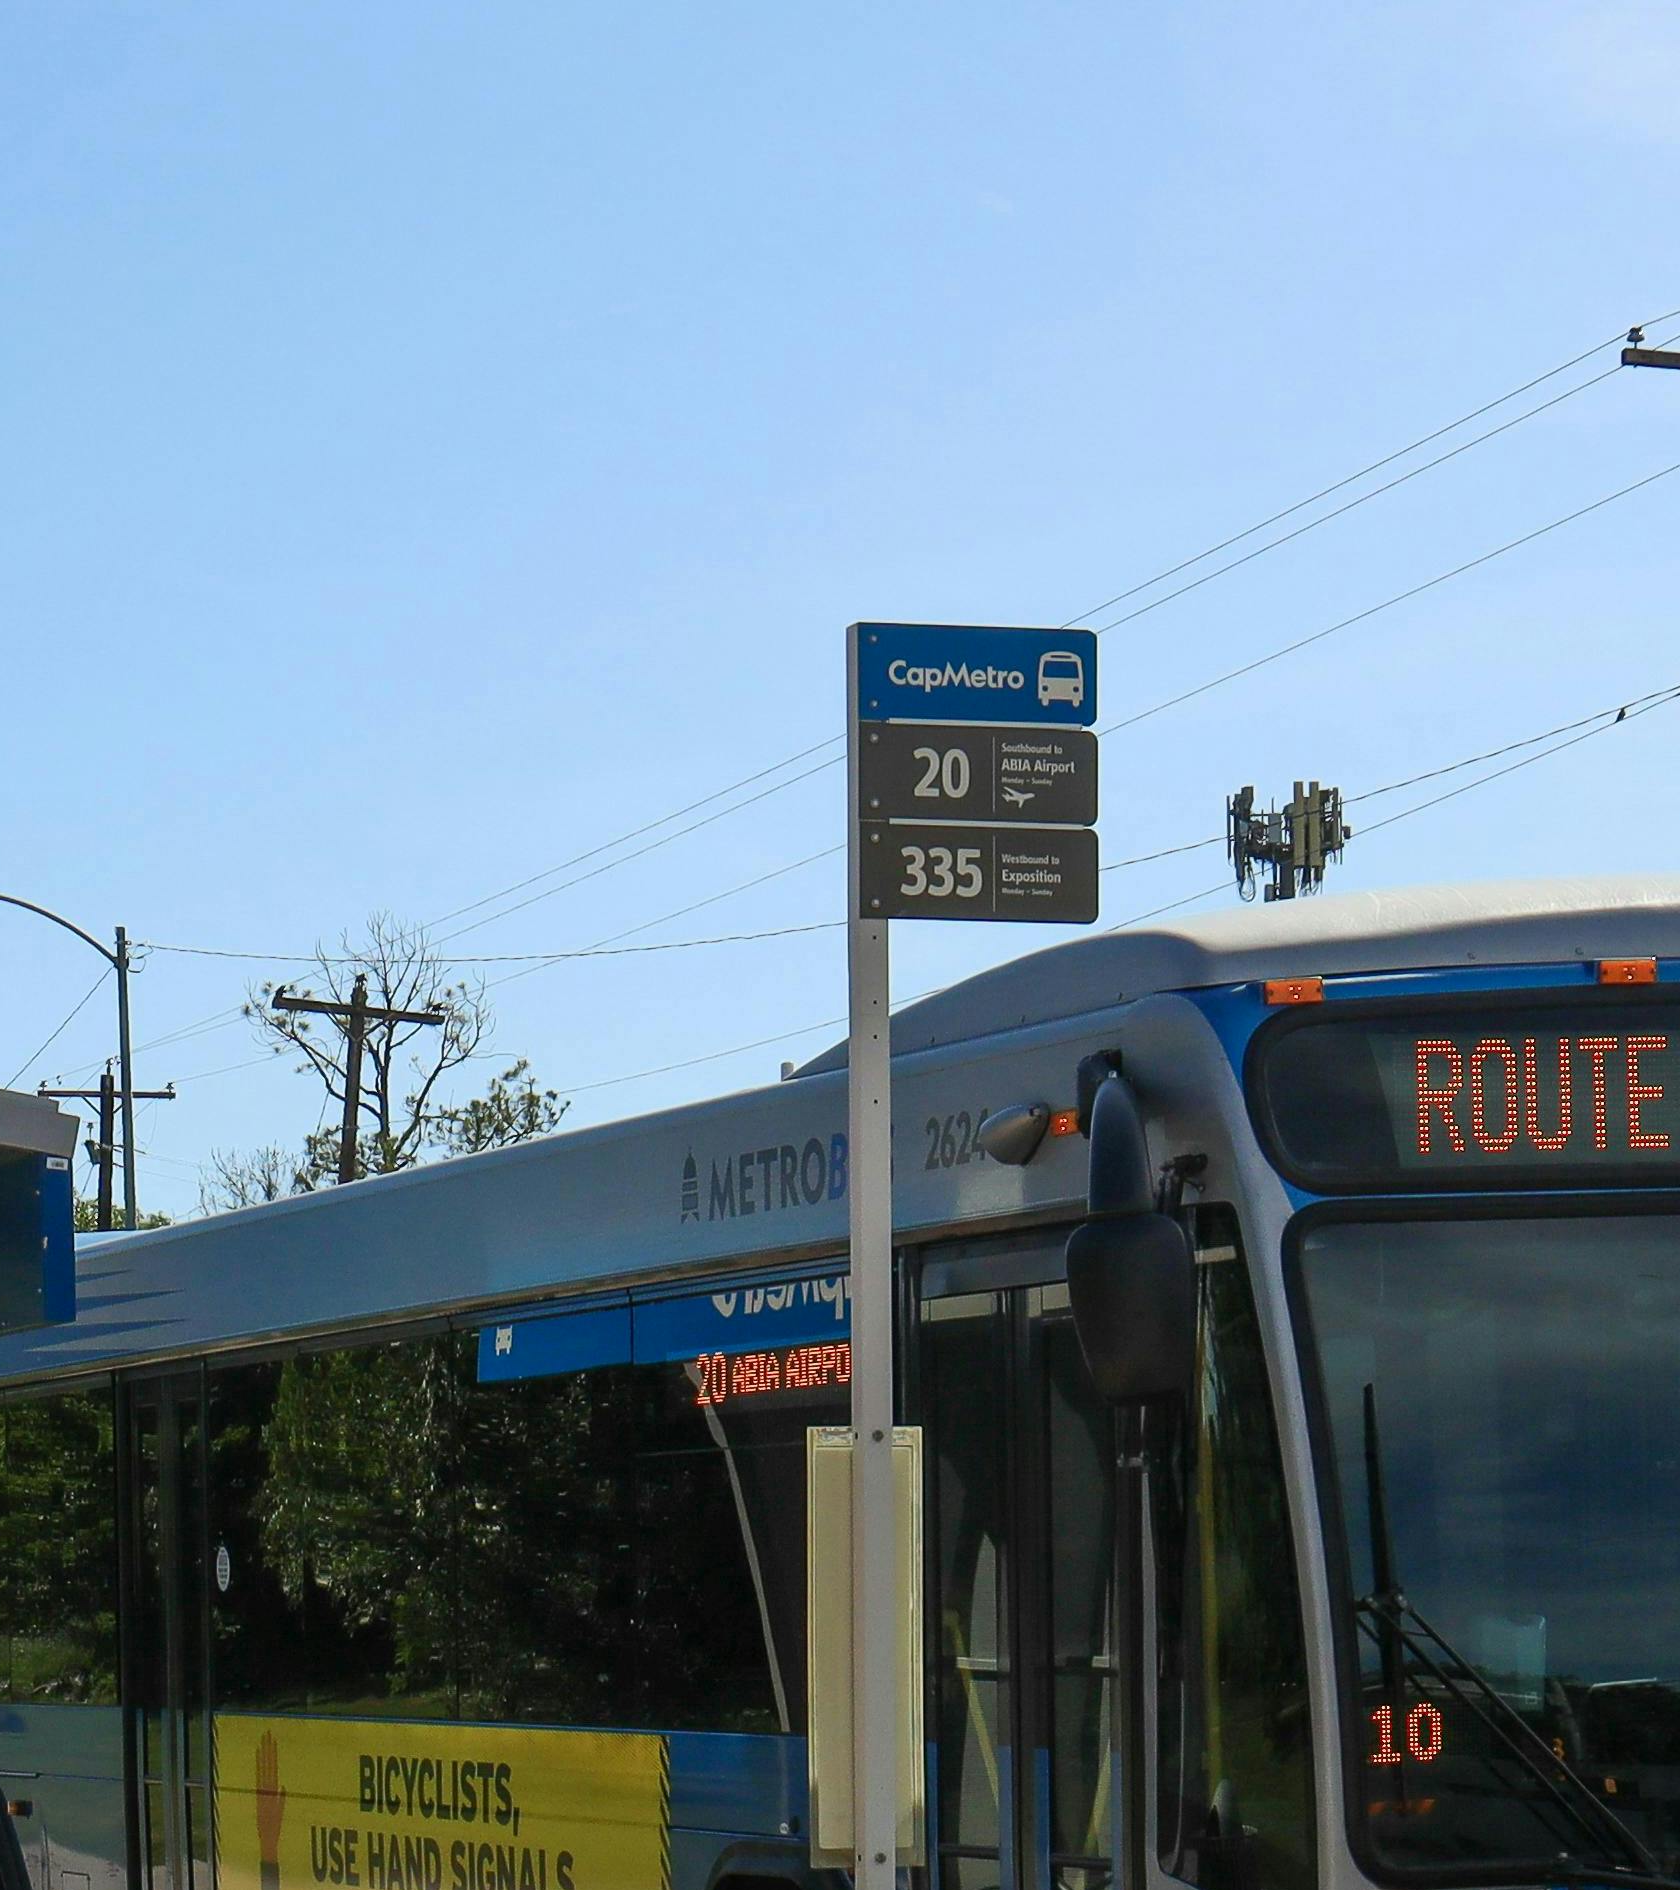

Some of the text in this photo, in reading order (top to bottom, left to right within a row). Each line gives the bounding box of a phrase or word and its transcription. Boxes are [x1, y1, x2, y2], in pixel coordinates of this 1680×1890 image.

[888, 660, 1024, 692] CapMetro
[913, 748, 970, 798] 20
[1001, 743, 1063, 754] Southbound to
[1002, 759, 1075, 775] ABIA Airport
[1032, 777, 1052, 786] Sunday
[900, 847, 983, 897] 335
[1001, 854, 1060, 865] Westbound to
[1002, 869, 1061, 885] Exposition
[1413, 1034, 1670, 1152] ROUTE
[925, 1108, 989, 1170] 2624
[709, 1127, 892, 1222] METROB
[696, 1343, 851, 1405] 20 ABIA AIRPO
[1368, 1702, 1442, 1766] 10
[359, 1754, 520, 1837] BICYCLISTS,
[311, 1825, 359, 1887] USE
